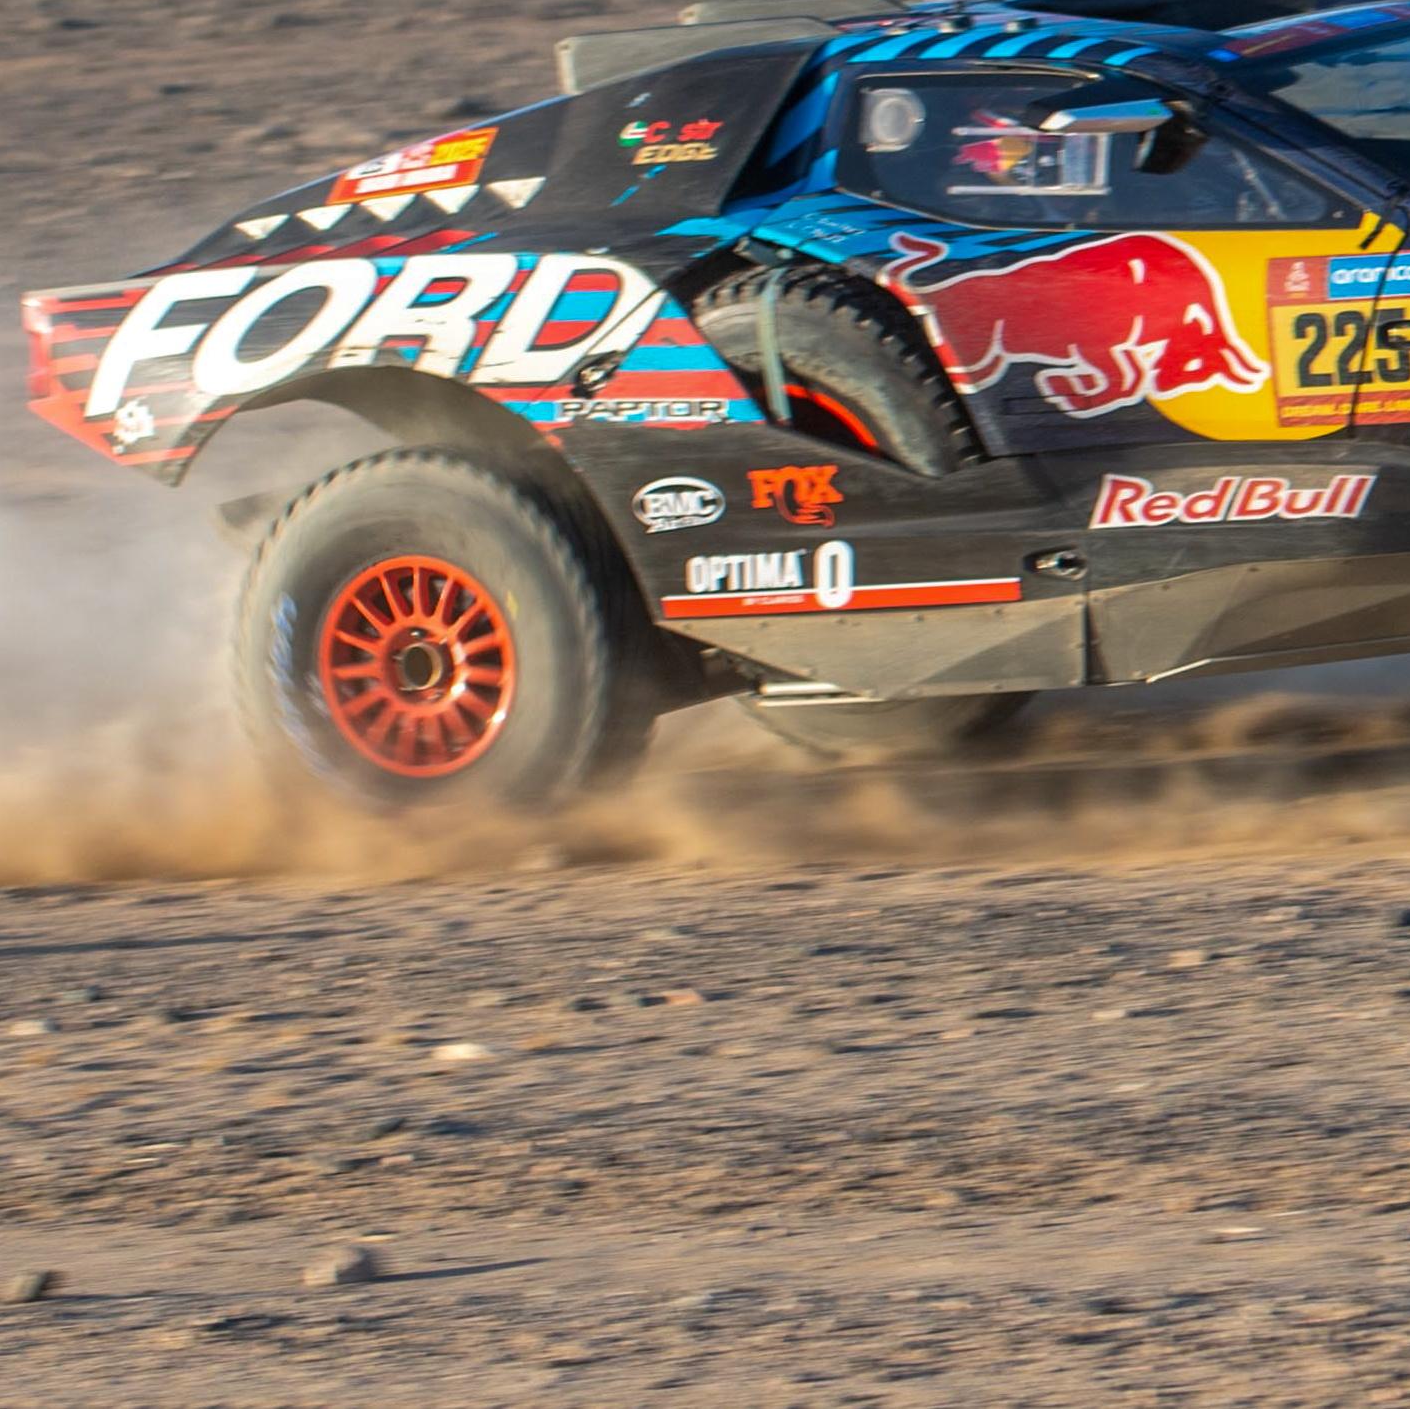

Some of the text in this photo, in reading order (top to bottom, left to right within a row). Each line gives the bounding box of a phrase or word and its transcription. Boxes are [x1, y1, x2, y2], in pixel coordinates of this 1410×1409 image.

[84, 253, 668, 418] FORD
[555, 399, 730, 424] RAPTOR
[746, 463, 845, 528] FOX
[1089, 474, 1377, 529] Red Bull
[685, 552, 806, 593] OPTIMA
